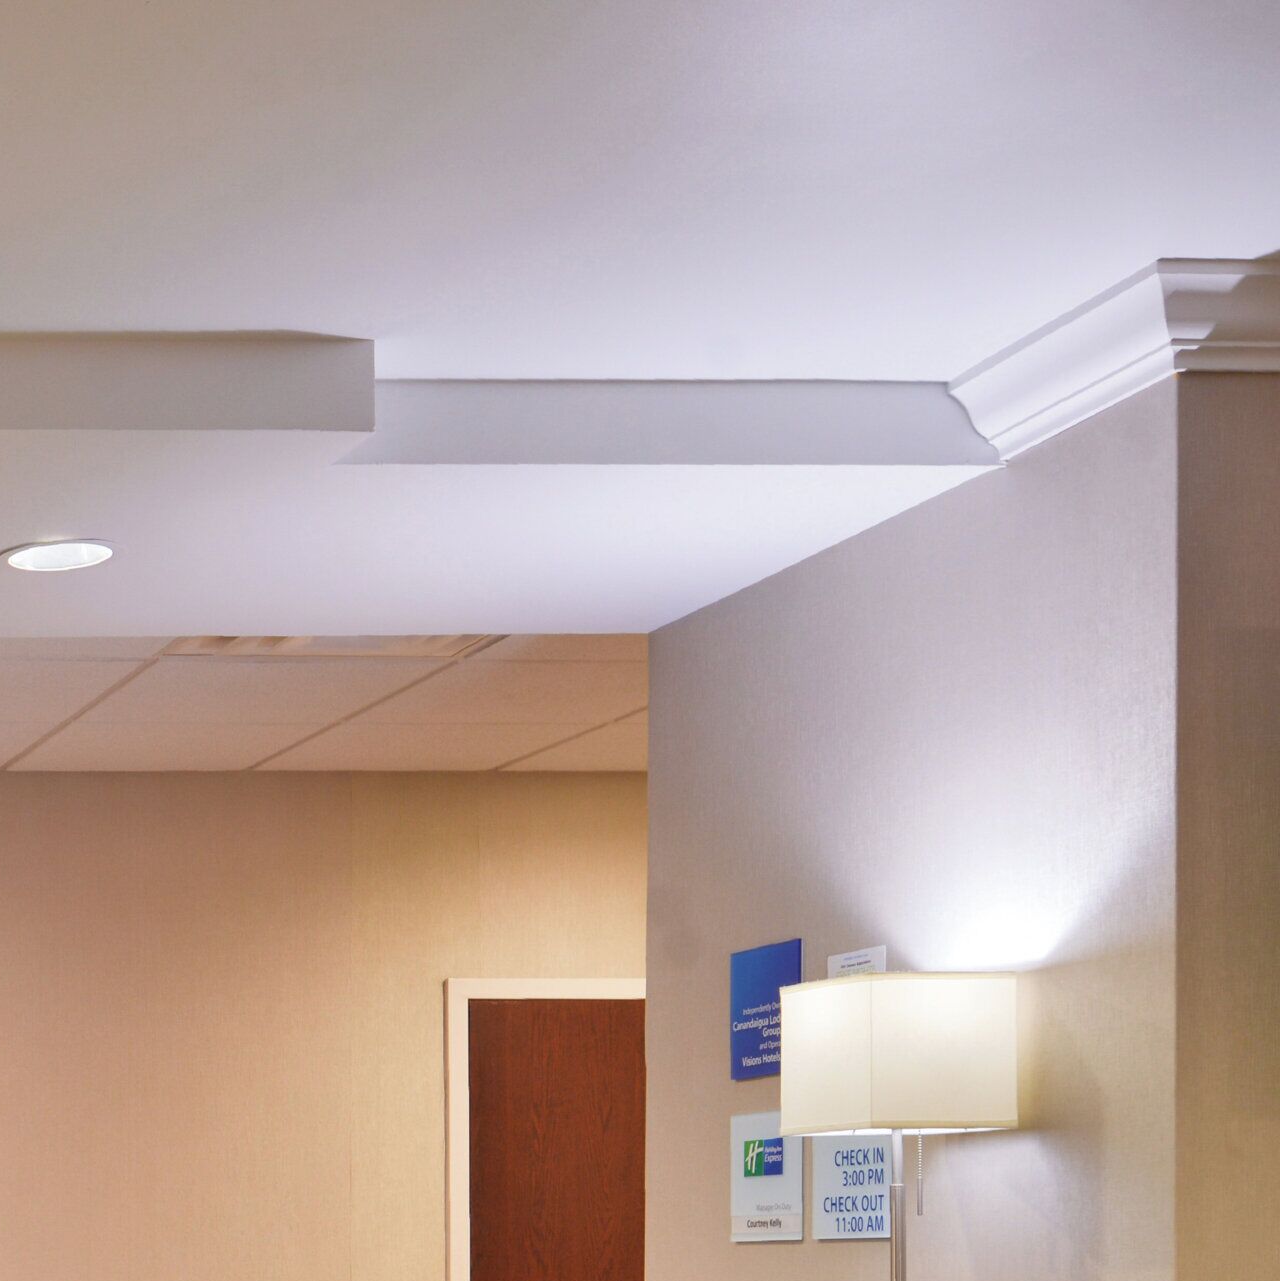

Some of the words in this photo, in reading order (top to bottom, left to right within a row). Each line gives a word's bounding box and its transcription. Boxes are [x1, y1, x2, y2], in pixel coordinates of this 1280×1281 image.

[732, 1017, 769, 1032] Canandaigua
[762, 1026, 781, 1037] Group
[742, 1056, 761, 1067] Visions
[762, 1051, 781, 1063] Hotels
[764, 1154, 782, 1164] Express
[834, 1148, 870, 1167] CHECK
[873, 1147, 884, 1164] IN
[842, 1170, 865, 1187] 3:00
[867, 1168, 884, 1185] PM
[823, 1196, 859, 1213] CHECK
[861, 1194, 884, 1212] OUT
[747, 1220, 768, 1230] Courtney
[770, 1219, 782, 1229] Kelly
[835, 1216, 864, 1233] 11:00
[866, 1215, 884, 1232] AM
